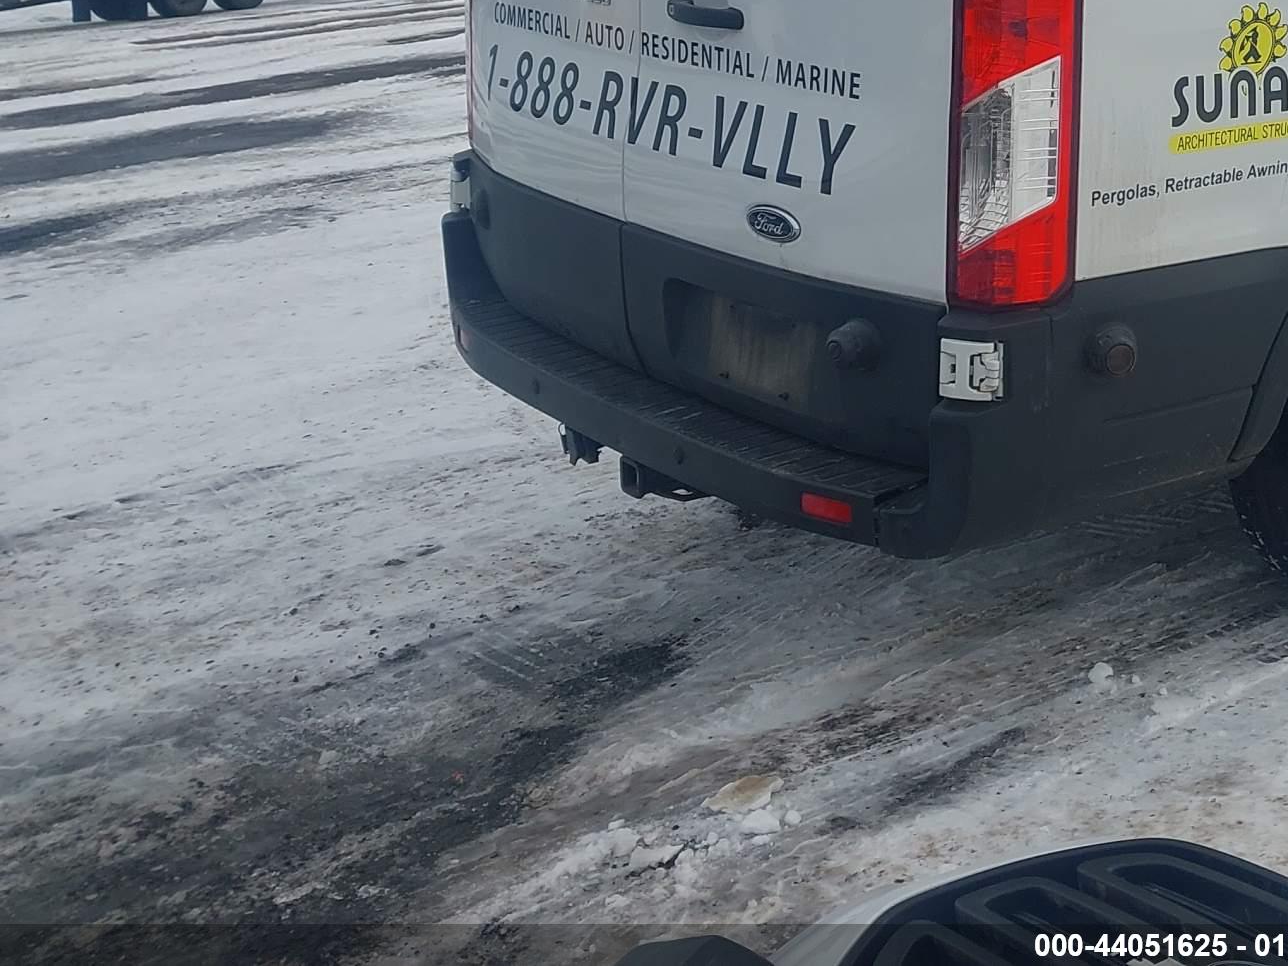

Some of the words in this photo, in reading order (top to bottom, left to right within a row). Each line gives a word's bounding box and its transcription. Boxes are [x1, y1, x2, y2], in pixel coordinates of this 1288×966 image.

[493, 1, 571, 41] COMMERCIAL
[584, 20, 625, 52] AUTO
[640, 31, 755, 79] RESIDENTIAL
[776, 58, 862, 100] MARINE
[486, 43, 857, 196] 1-888-RVR-VLLY
[1176, 124, 1259, 152] ARCHITECTURAL
[1091, 184, 1160, 207] Pergolas,
[1165, 167, 1244, 194] Retractable
[755, 212, 784, 235] Ford
